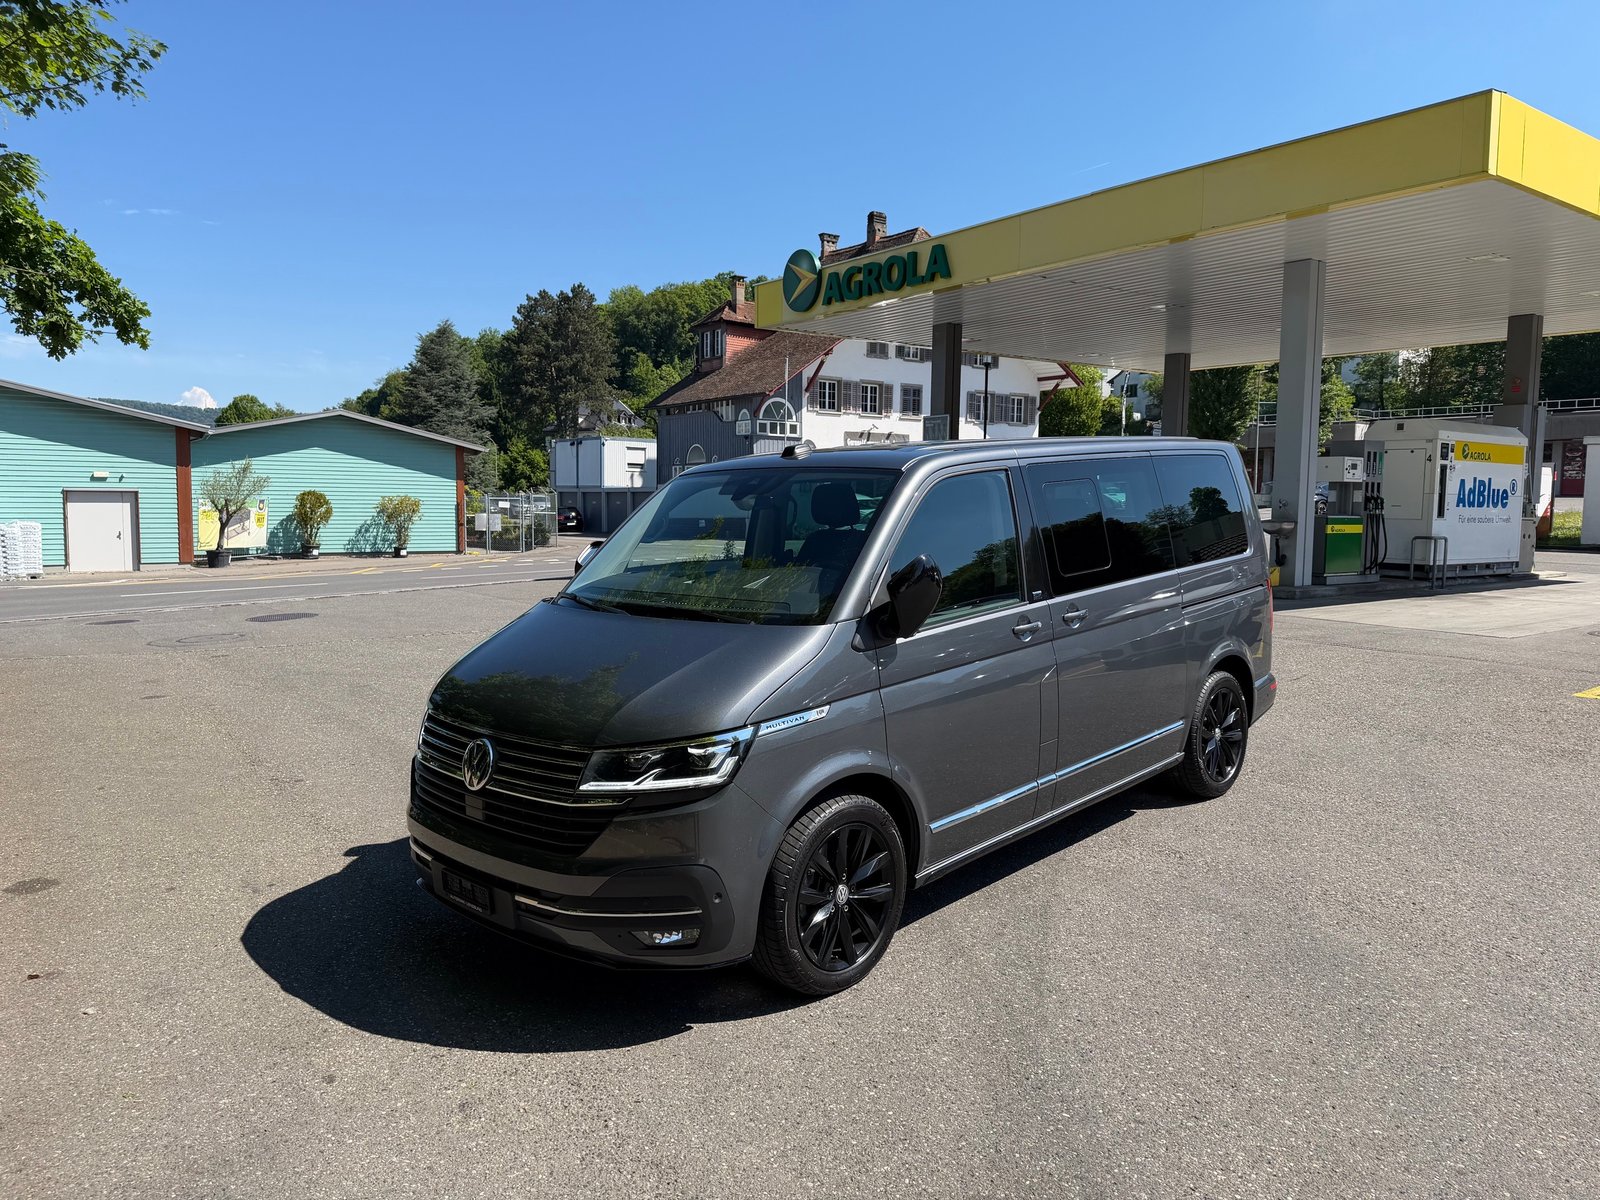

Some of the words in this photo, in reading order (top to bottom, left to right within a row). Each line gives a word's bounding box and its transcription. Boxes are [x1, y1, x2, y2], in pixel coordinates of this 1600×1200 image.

[821, 244, 952, 306] AGROLA
[1426, 453, 1433, 463] 4
[1469, 451, 1492, 462] AGROLA
[766, 715, 805, 730] MULTIVAN
